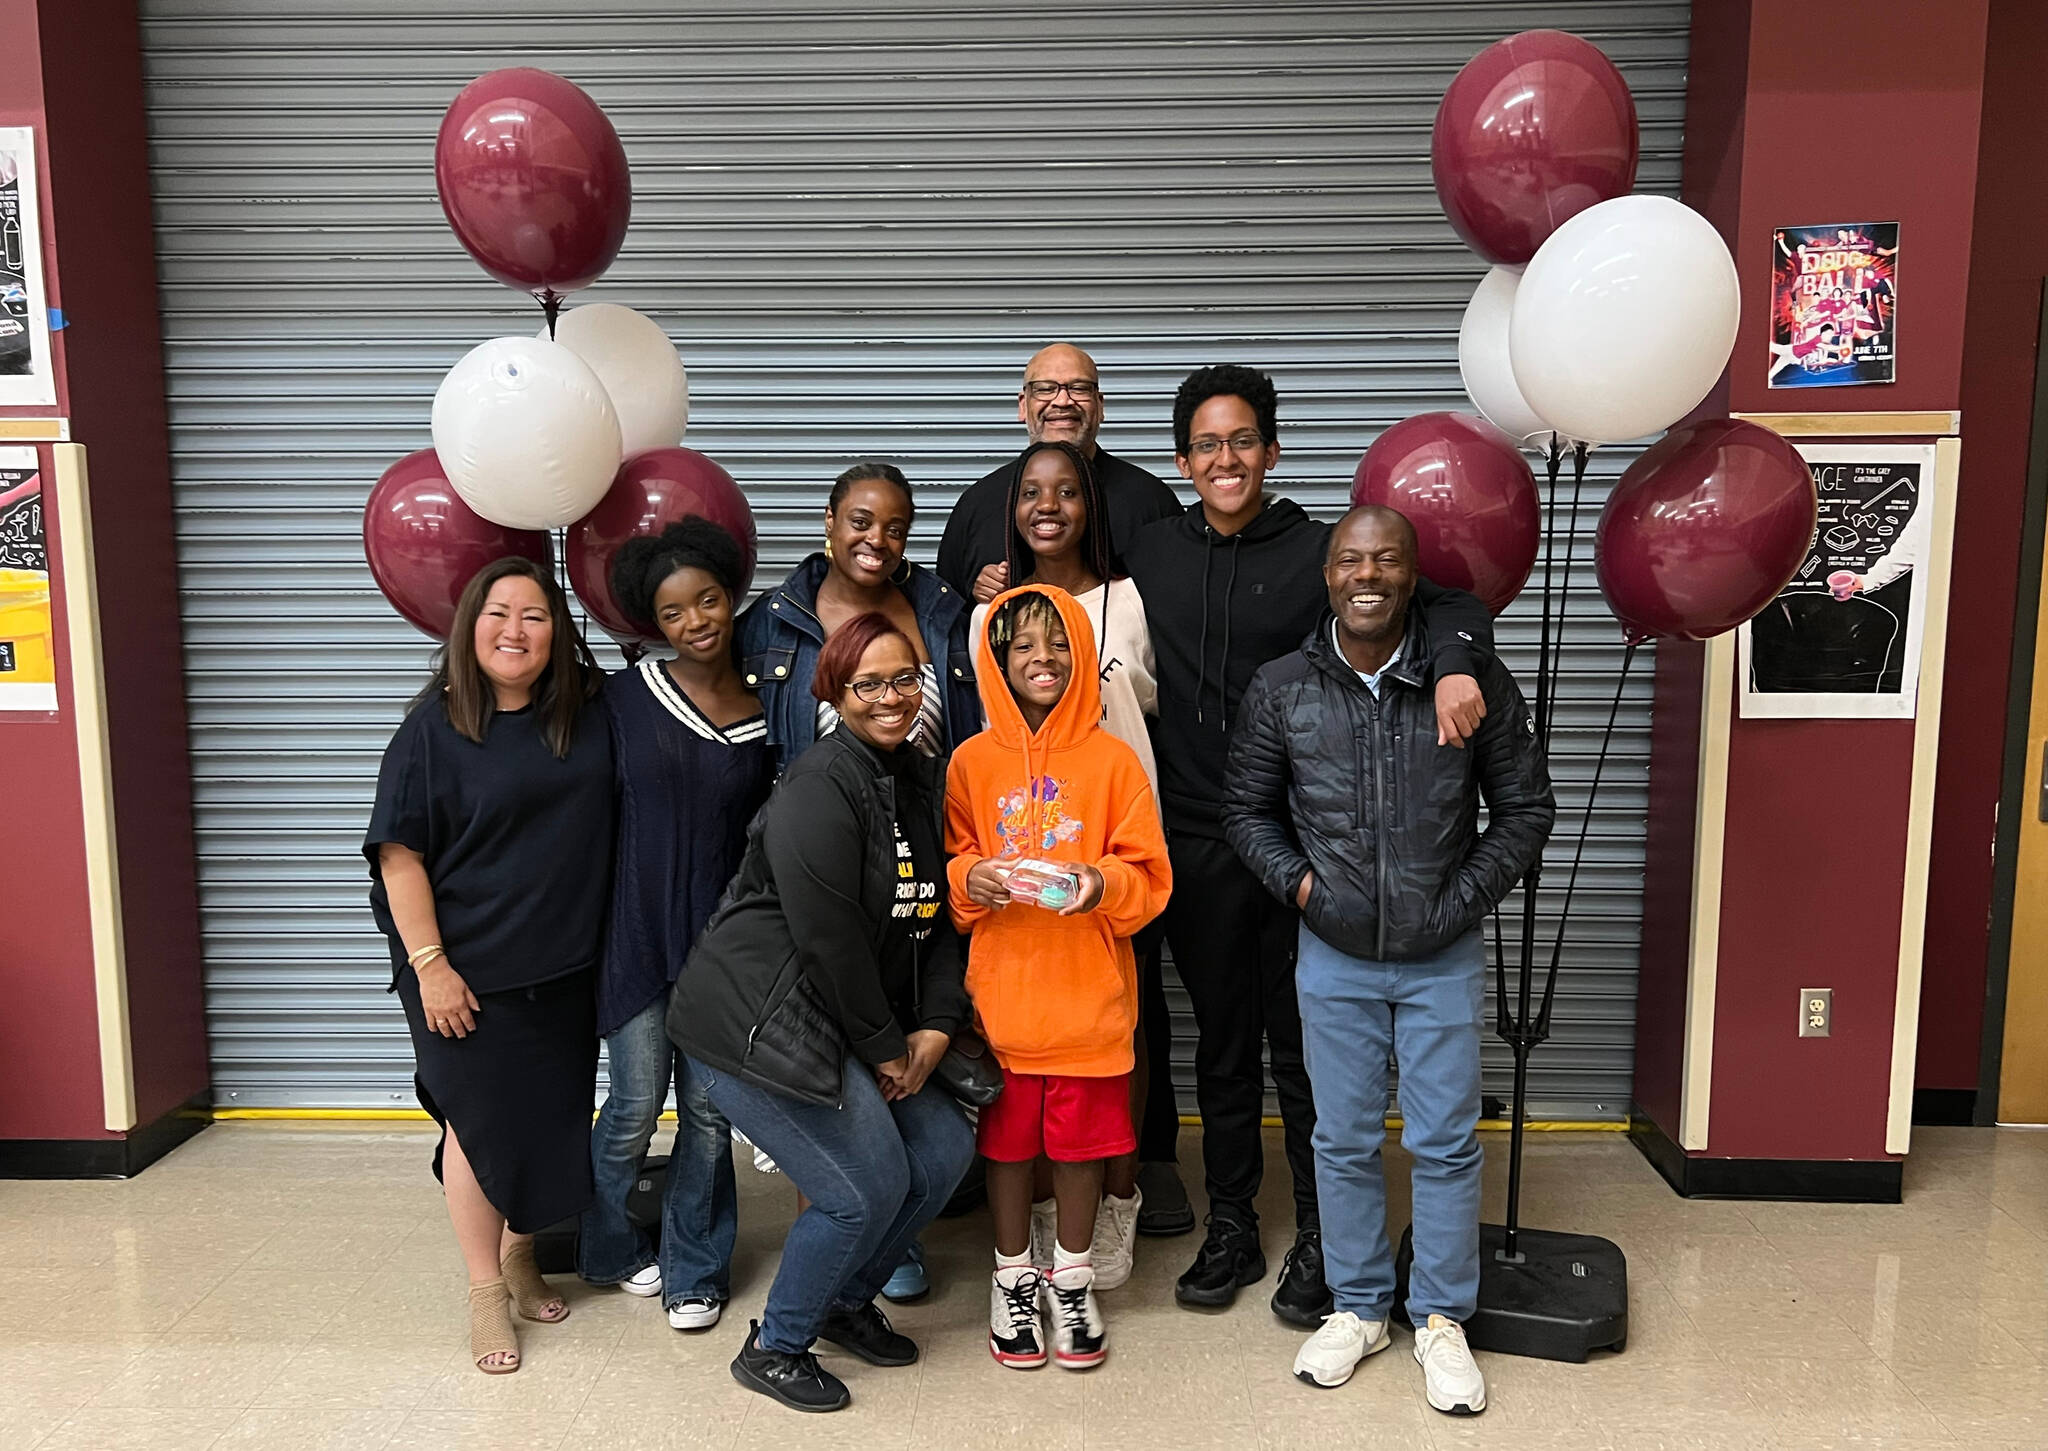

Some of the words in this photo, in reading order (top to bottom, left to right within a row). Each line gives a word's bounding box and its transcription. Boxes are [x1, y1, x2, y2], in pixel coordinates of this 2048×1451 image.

[1873, 345, 1888, 354] 7TH
[1813, 467, 1847, 491] AGE
[919, 882, 935, 899] DO
